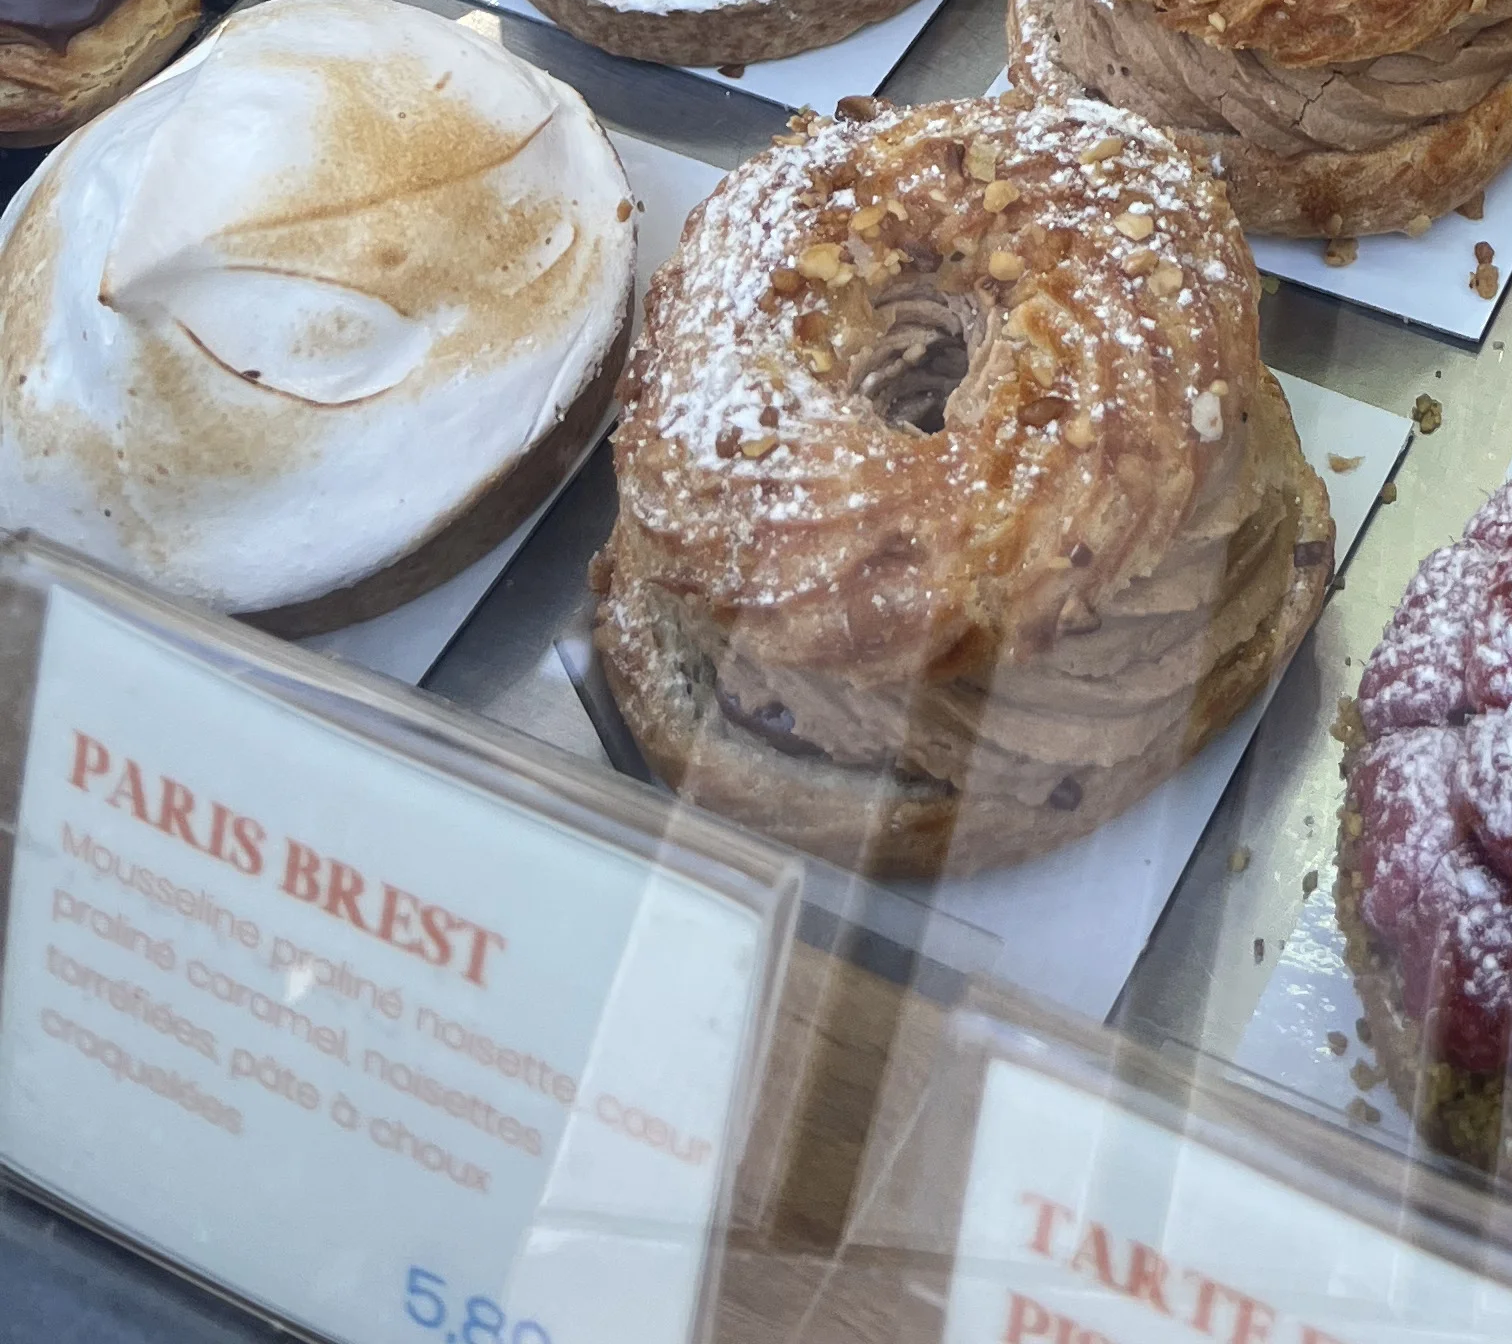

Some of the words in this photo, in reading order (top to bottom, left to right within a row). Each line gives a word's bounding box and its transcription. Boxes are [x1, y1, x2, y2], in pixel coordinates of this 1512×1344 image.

[60, 820, 260, 949] Mousseline
[68, 728, 267, 876] PARIS
[278, 836, 507, 989] BREST
[364, 1048, 543, 1158] noisettes
[1018, 1188, 1279, 1344] TARTE
